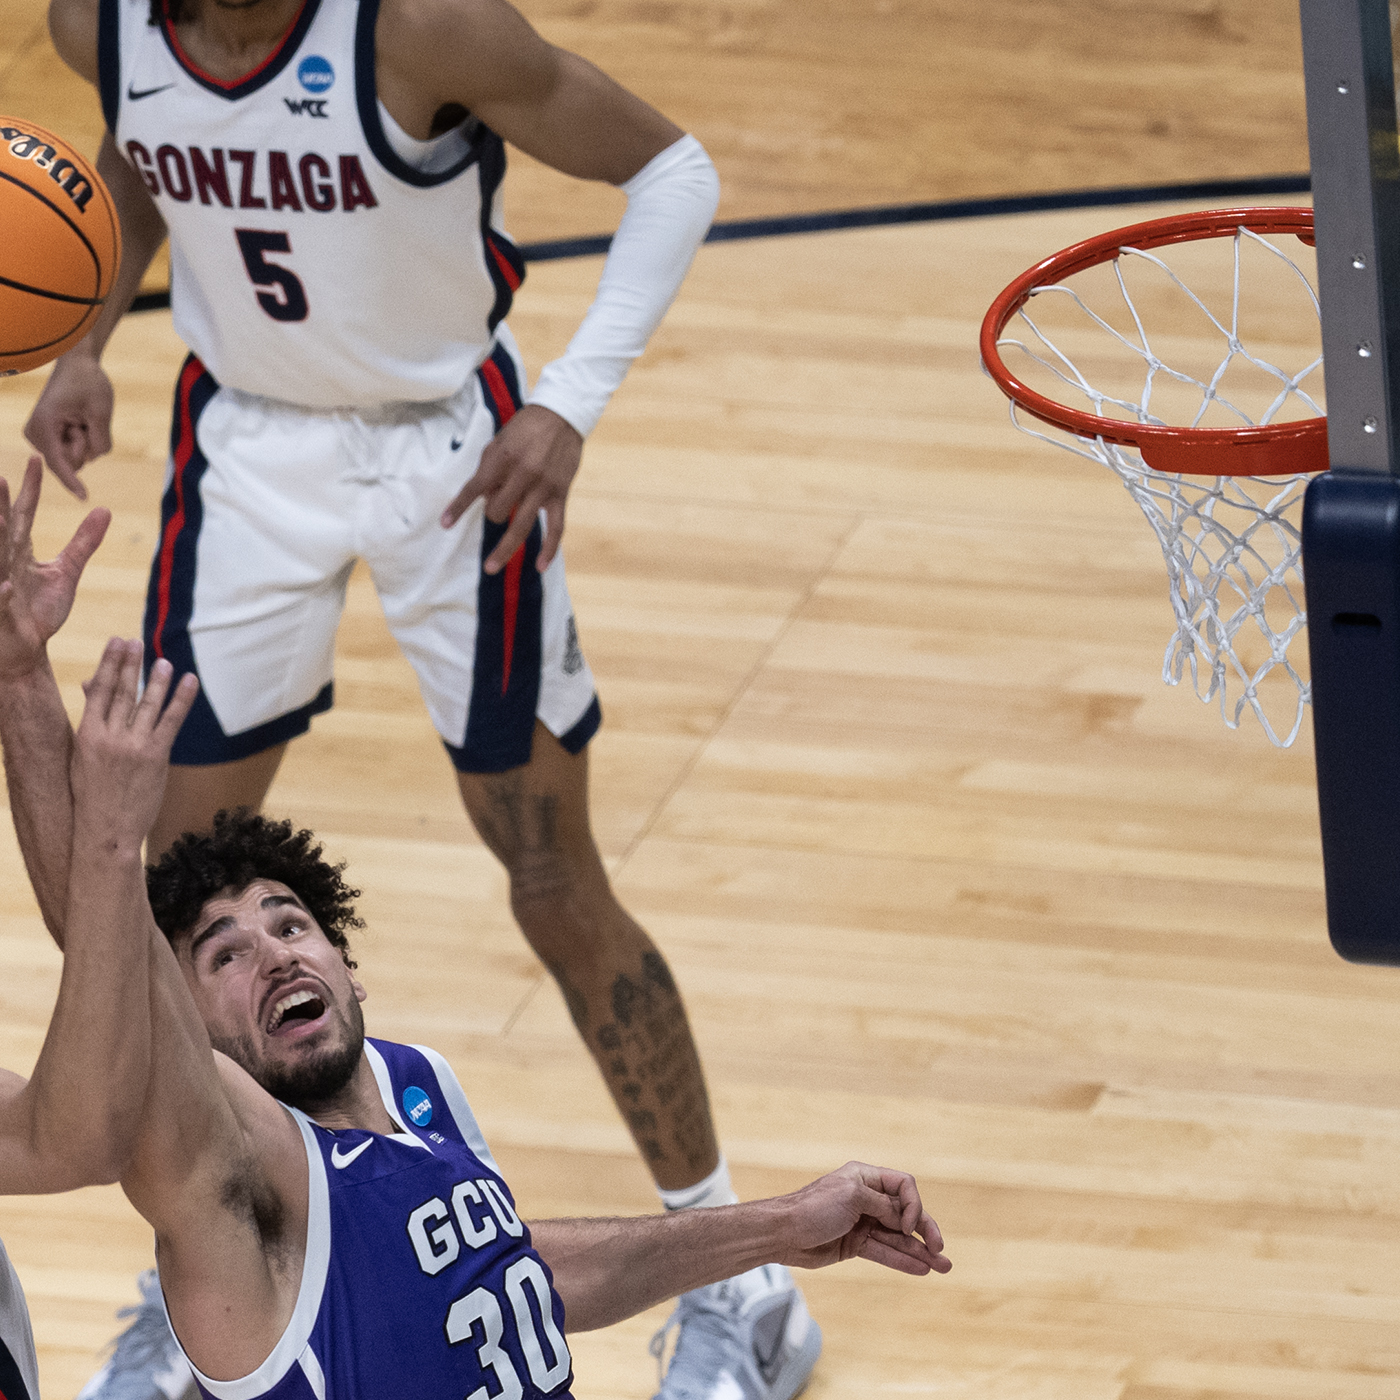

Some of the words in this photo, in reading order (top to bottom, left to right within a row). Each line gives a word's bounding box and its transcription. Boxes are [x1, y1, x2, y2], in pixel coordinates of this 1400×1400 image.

[125, 139, 379, 213] GONZAGA
[234, 226, 310, 323] 5
[406, 1178, 524, 1276] GCU
